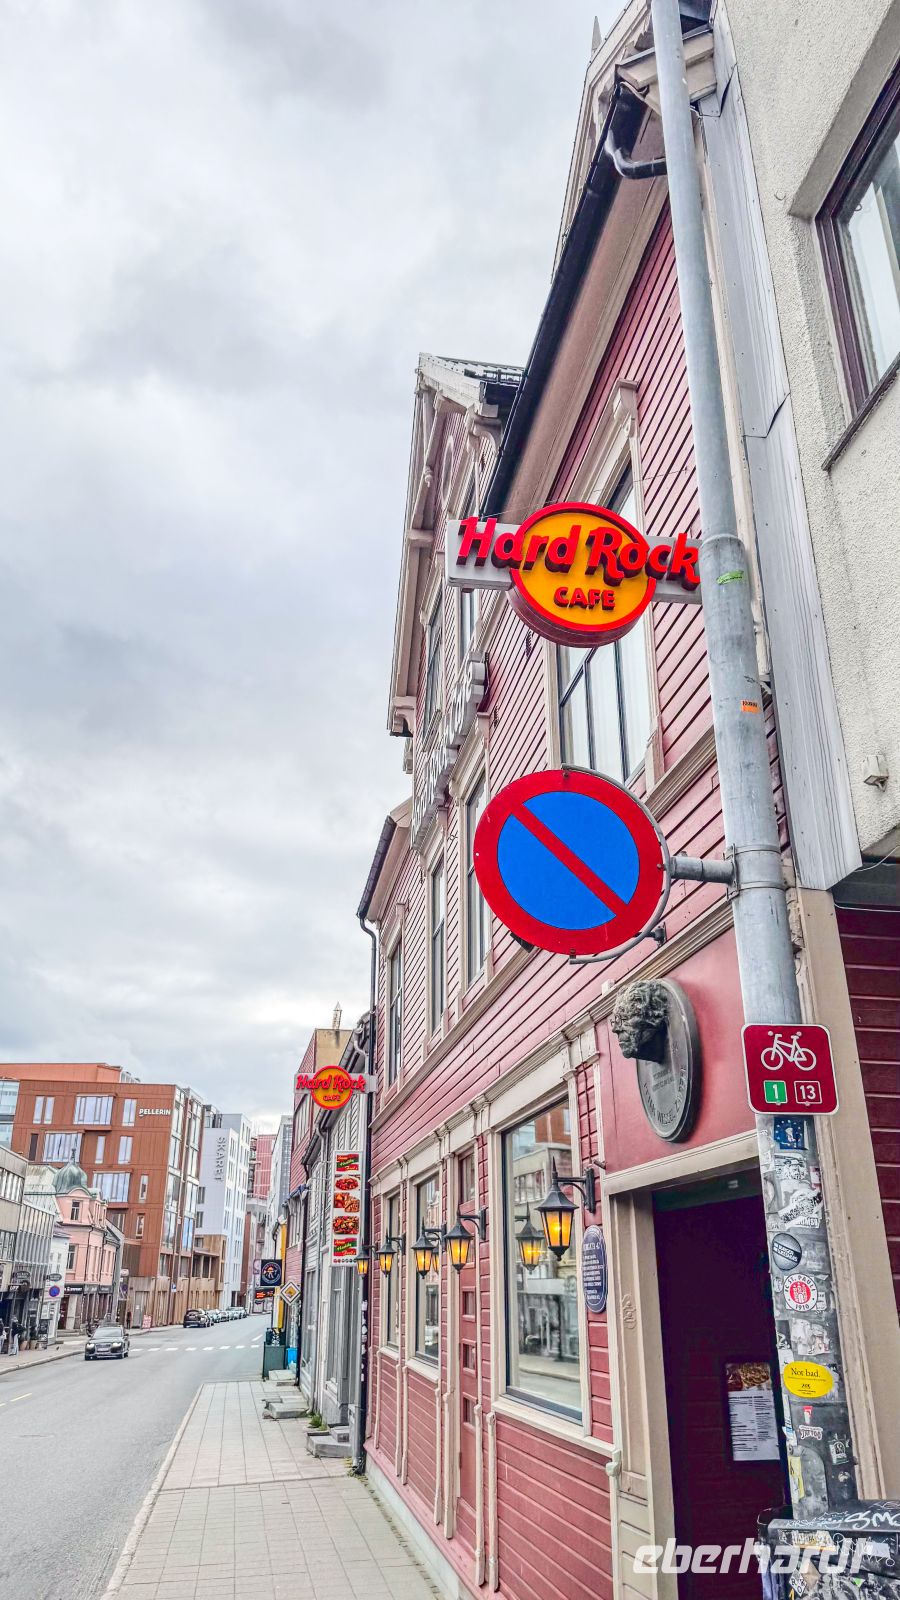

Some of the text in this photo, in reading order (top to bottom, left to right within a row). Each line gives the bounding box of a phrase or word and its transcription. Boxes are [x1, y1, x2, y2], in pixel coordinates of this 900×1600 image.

[456, 516, 701, 592] Hard Rock
[553, 586, 616, 610] CAFE
[296, 1074, 366, 1093] Hard Rock
[772, 1084, 816, 1100] 1 13
[139, 1108, 171, 1116] PELLERIN
[791, 1367, 821, 1378] Not bad.
